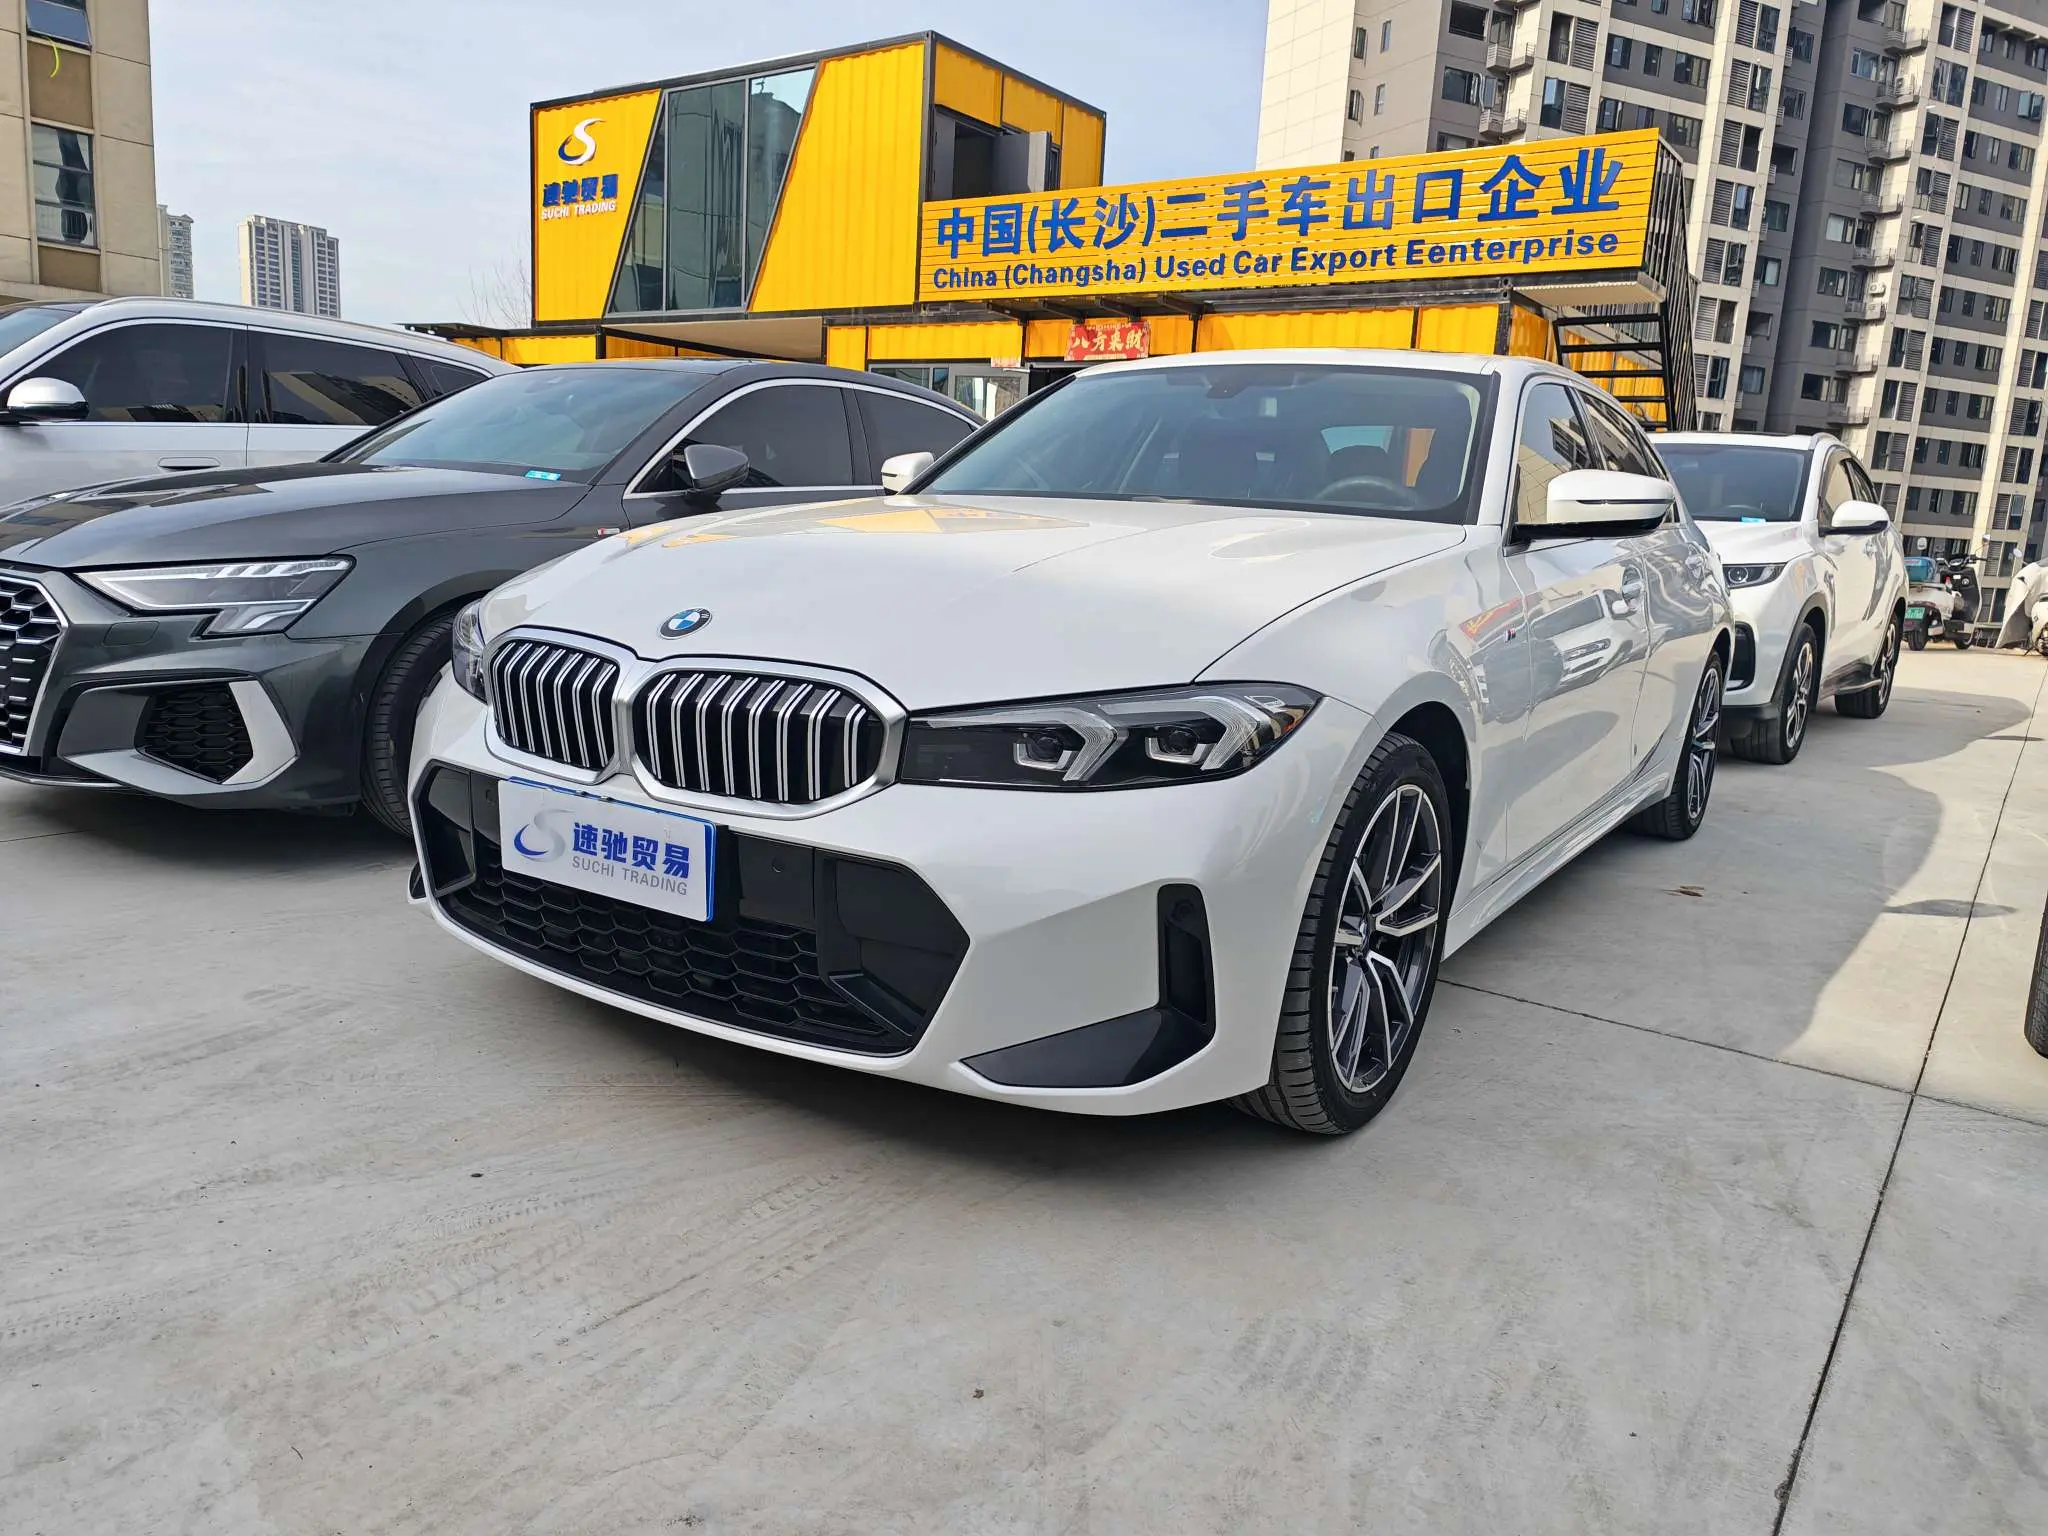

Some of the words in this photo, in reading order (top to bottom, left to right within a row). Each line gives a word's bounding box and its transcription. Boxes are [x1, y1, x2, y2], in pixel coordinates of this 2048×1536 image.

[542, 206, 570, 220] SUCHI
[574, 200, 617, 216] TRADING
[937, 147, 1624, 259] 中国(长沙)二手车出口企业
[933, 266, 997, 288] China
[1005, 257, 1146, 289] (Changsha)
[1155, 253, 1225, 278] Used
[1233, 250, 1283, 273] Car
[1290, 244, 1397, 276] Export
[1406, 229, 1619, 265] Eenterprise
[572, 822, 690, 879] 速驰贸易
[572, 856, 614, 877] SUCHI
[622, 867, 688, 896] TRADING
